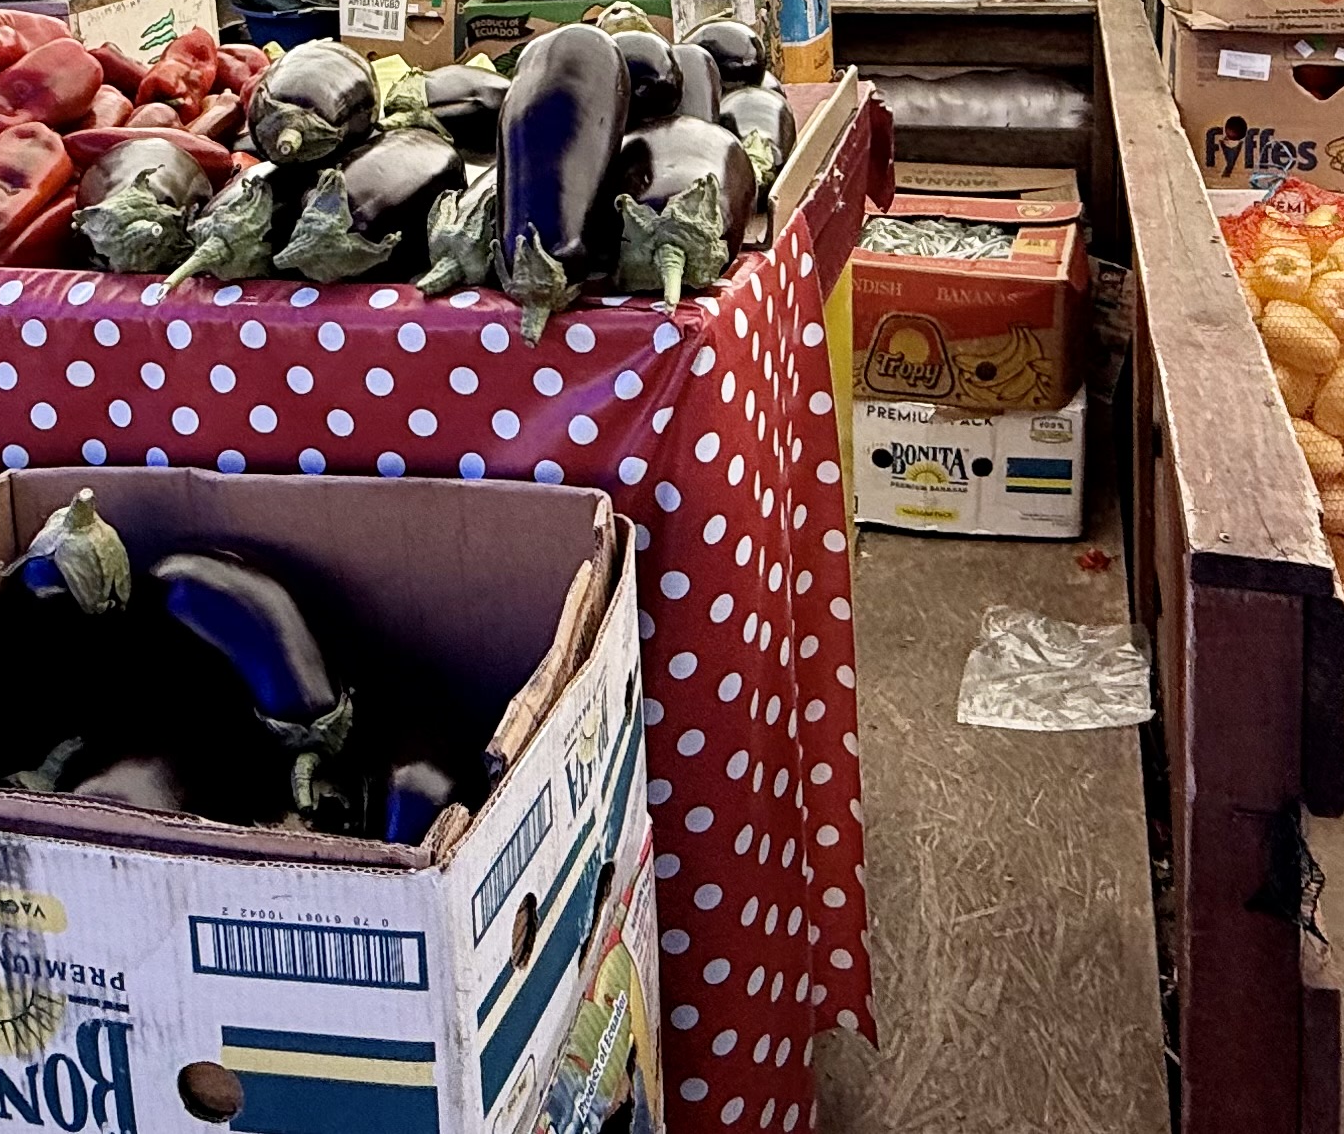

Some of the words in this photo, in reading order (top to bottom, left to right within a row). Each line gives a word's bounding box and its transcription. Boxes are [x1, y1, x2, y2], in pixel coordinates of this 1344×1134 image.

[471, 18, 508, 30] PRODUCT
[474, 26, 522, 38] ECUADOR
[936, 286, 1018, 304] BANANAS
[876, 352, 942, 390] Tropy
[866, 404, 934, 424] PREMIU
[890, 442, 969, 481] BONITA
[239, 907, 284, 921] 10042
[577, 1060, 602, 1117] Product
[603, 993, 628, 1050] Ecuador
